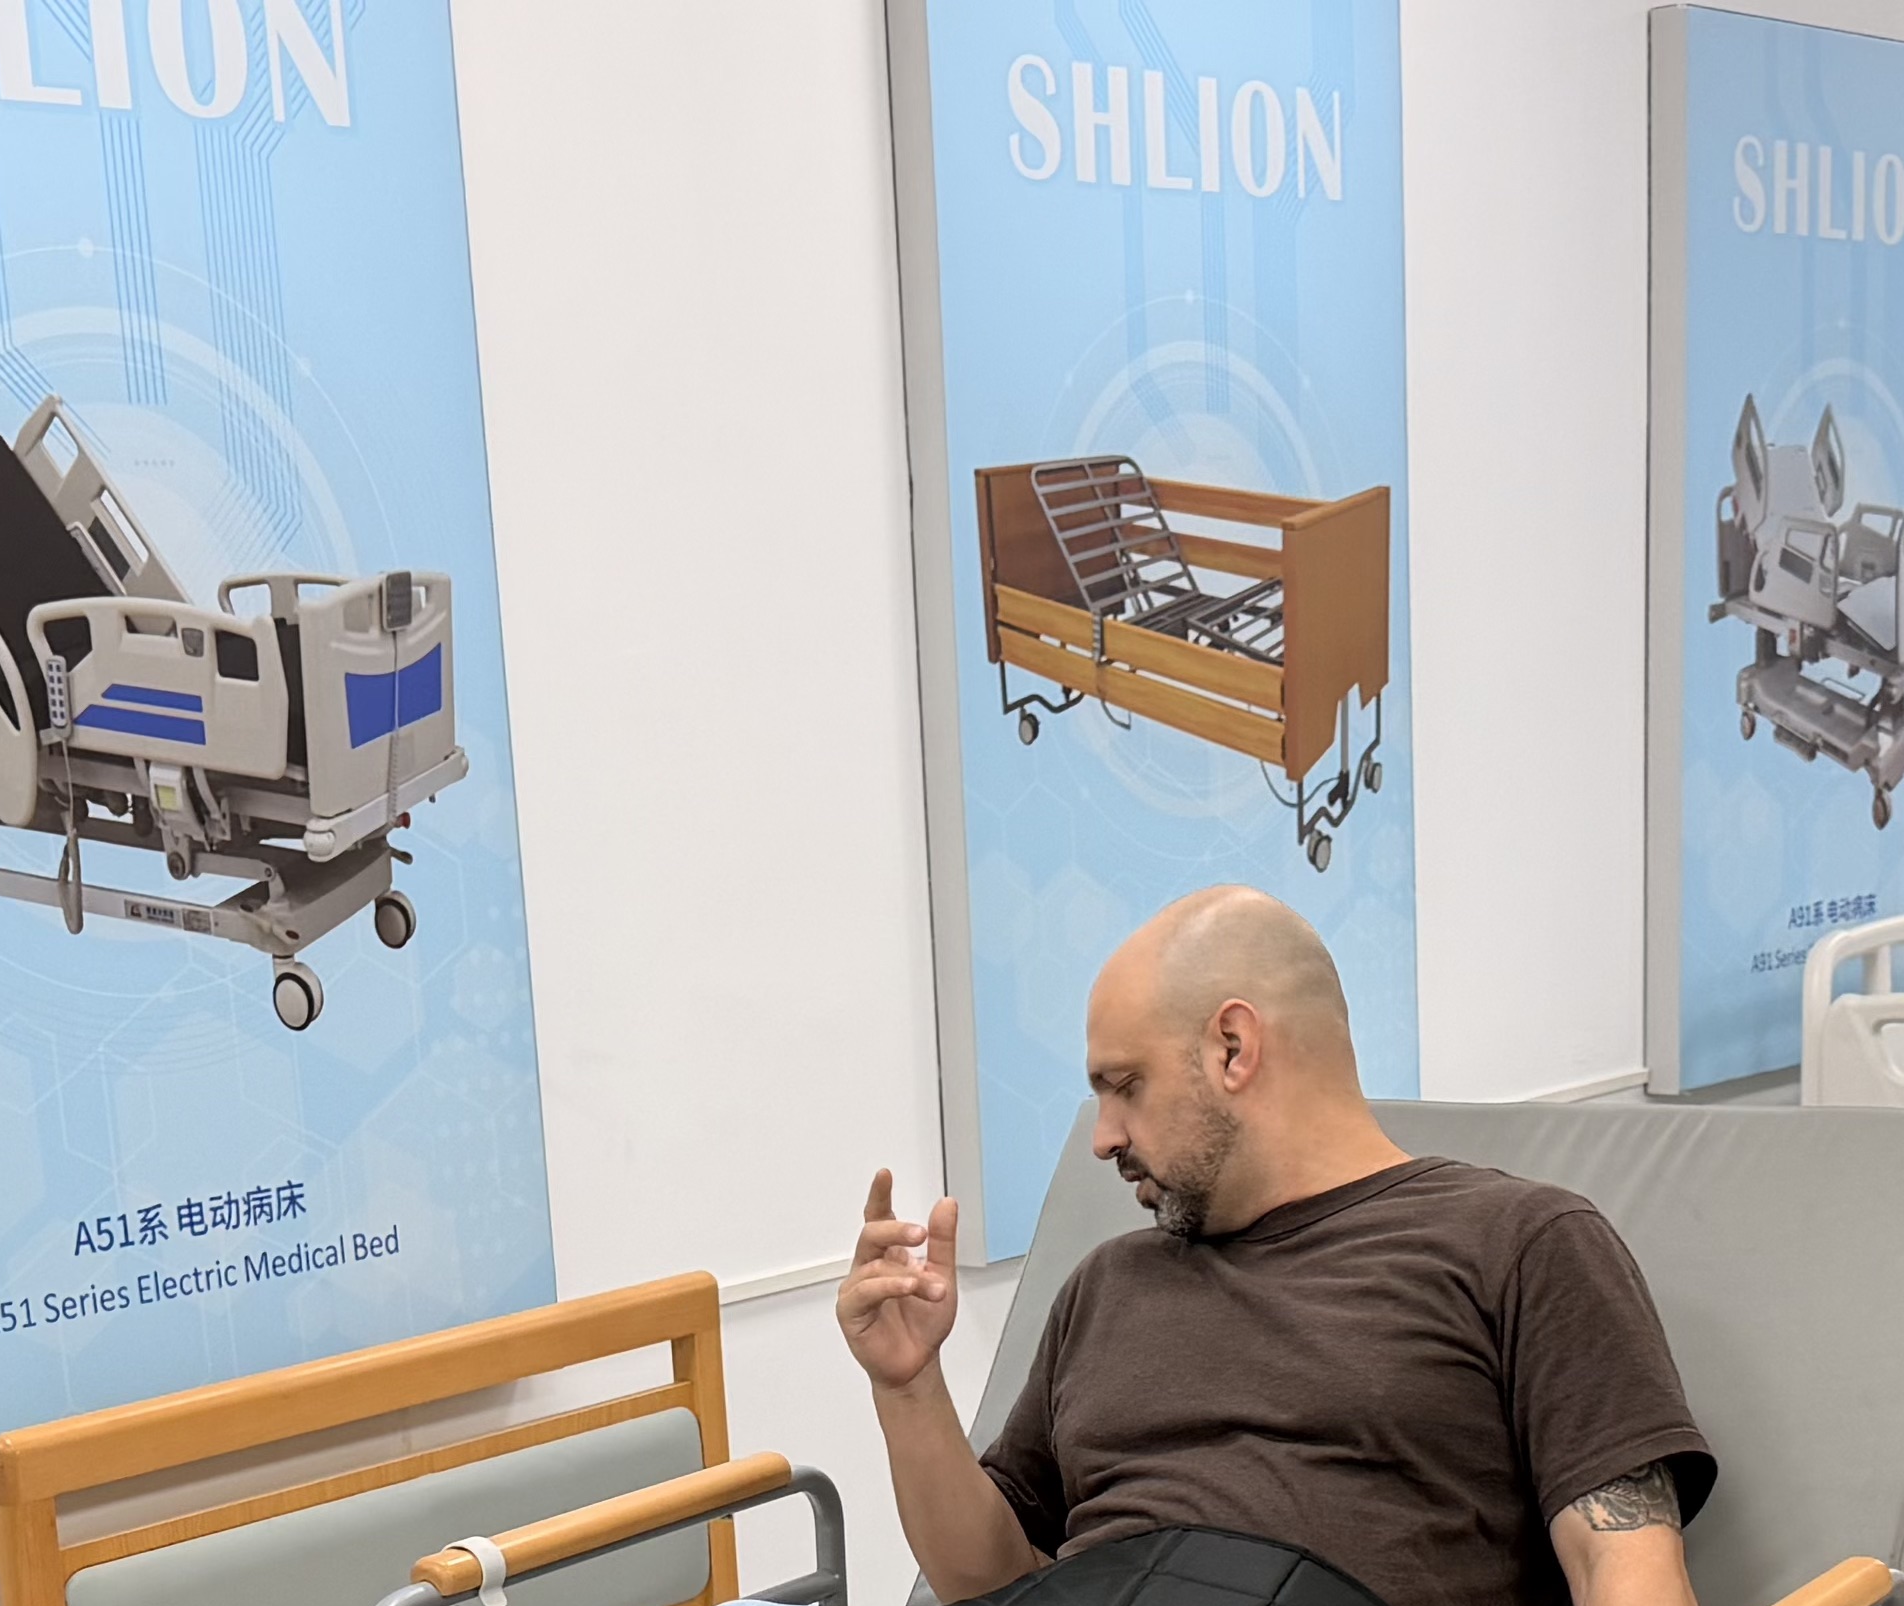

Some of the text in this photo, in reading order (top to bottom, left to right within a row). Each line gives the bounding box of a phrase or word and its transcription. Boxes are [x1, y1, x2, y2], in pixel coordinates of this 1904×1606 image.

[1007, 53, 1343, 202] SHLION
[74, 1180, 307, 1256] A51系 电动病床
[44, 1284, 131, 1324] Series
[137, 1260, 238, 1306] Electric
[244, 1233, 346, 1284] Medical
[353, 1224, 400, 1263] Bed
